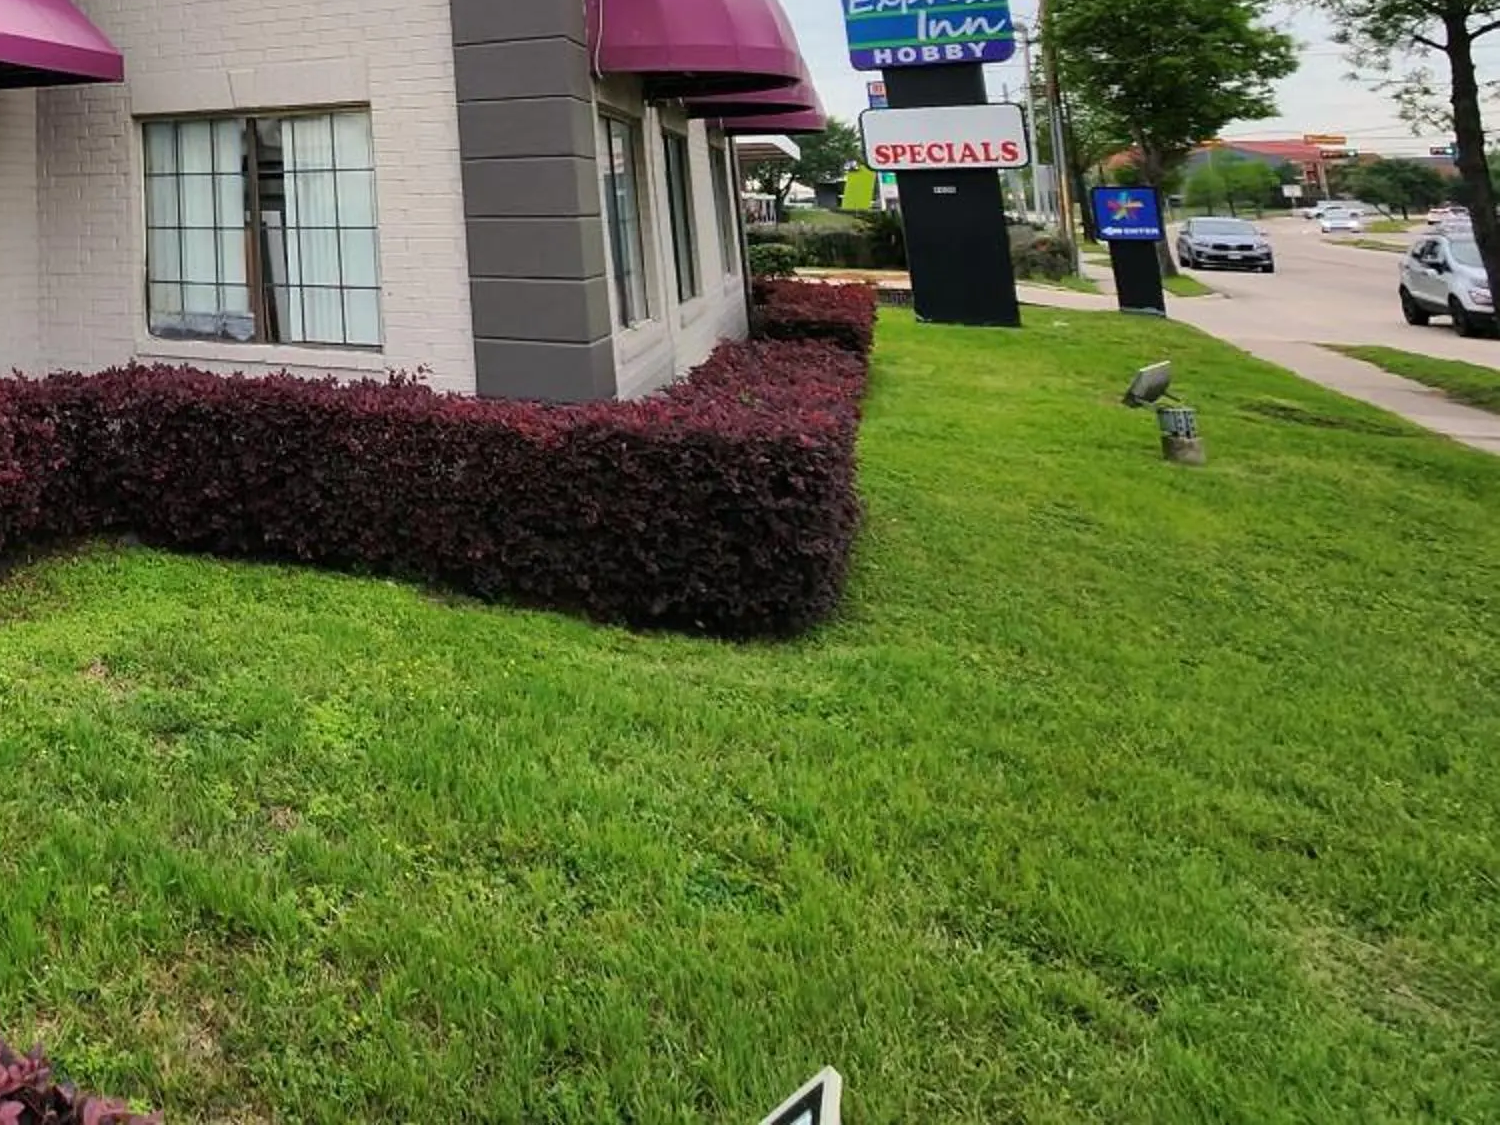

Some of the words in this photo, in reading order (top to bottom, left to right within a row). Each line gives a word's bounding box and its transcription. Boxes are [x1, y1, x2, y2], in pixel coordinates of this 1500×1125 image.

[916, 9, 1006, 41] Inn
[873, 42, 988, 64] HOBBY
[874, 141, 1019, 165] SPECIALS
